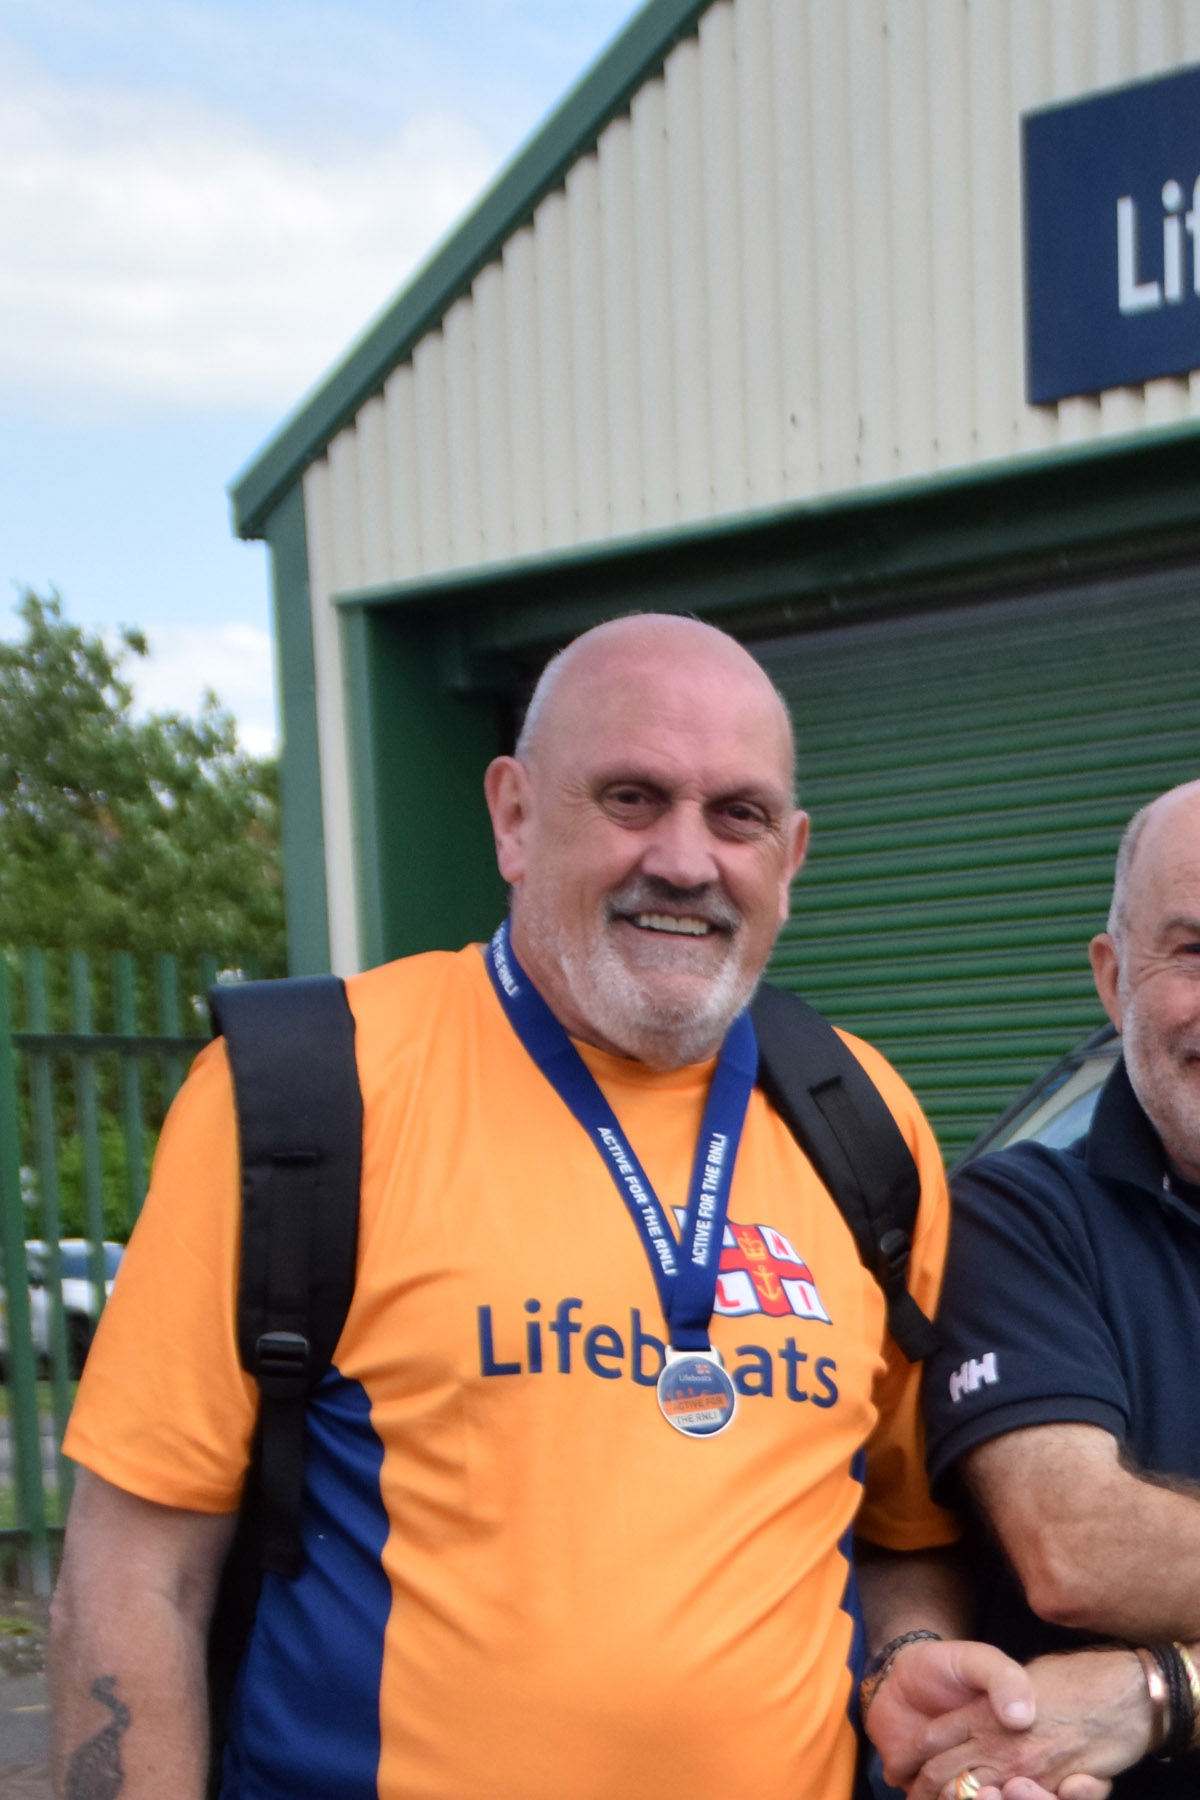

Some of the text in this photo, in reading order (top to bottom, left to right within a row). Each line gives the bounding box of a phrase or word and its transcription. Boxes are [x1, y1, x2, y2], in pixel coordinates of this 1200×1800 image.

[597, 1127, 677, 1275] ACTIVE FOR THE RNLI
[691, 1132, 727, 1266] ACTIVE FOR THE RNLI
[477, 1297, 839, 1409] Lifebats
[949, 1352, 998, 1403] HH
[677, 1411, 717, 1425] THE RNLI
